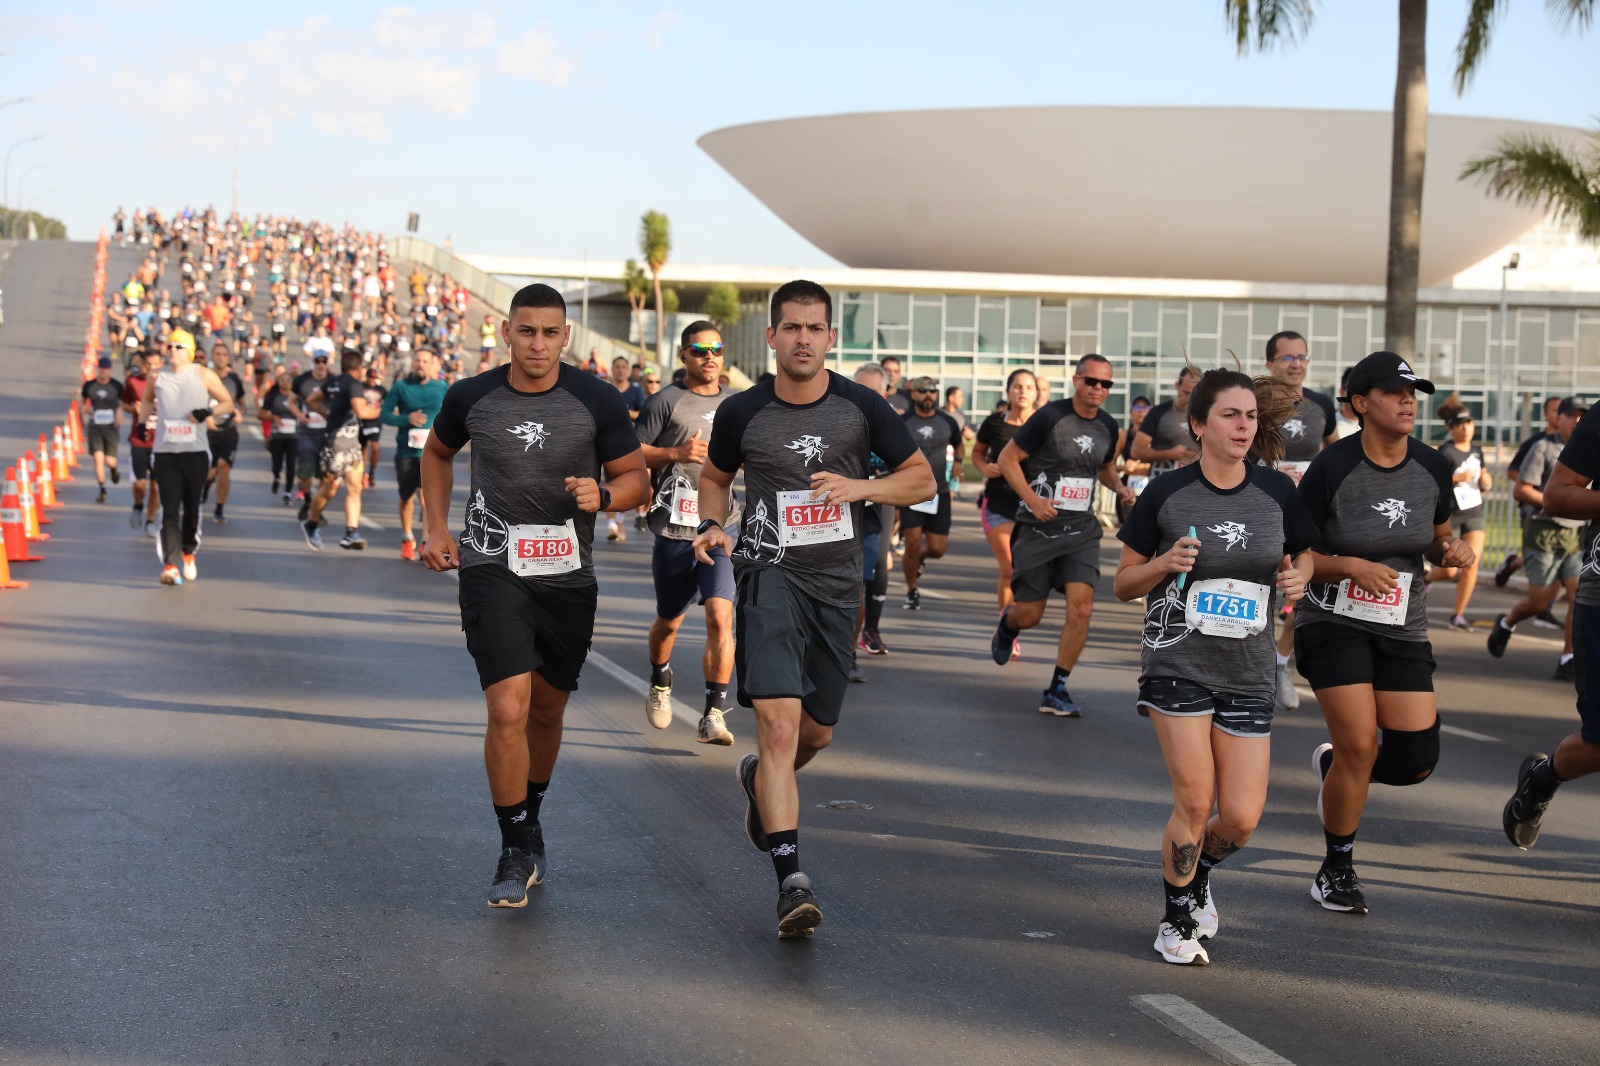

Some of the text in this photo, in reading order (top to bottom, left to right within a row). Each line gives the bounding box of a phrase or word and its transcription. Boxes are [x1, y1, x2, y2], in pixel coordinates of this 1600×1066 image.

[1064, 487, 1087, 498] 5785
[682, 500, 698, 512] 68
[791, 505, 837, 524] 6172
[523, 541, 569, 556] 5180
[1353, 585, 1397, 604] 65
[1204, 594, 1249, 617] 1751
[1201, 614, 1227, 623] DANIELA
[1226, 617, 1250, 626] ARAUJO
